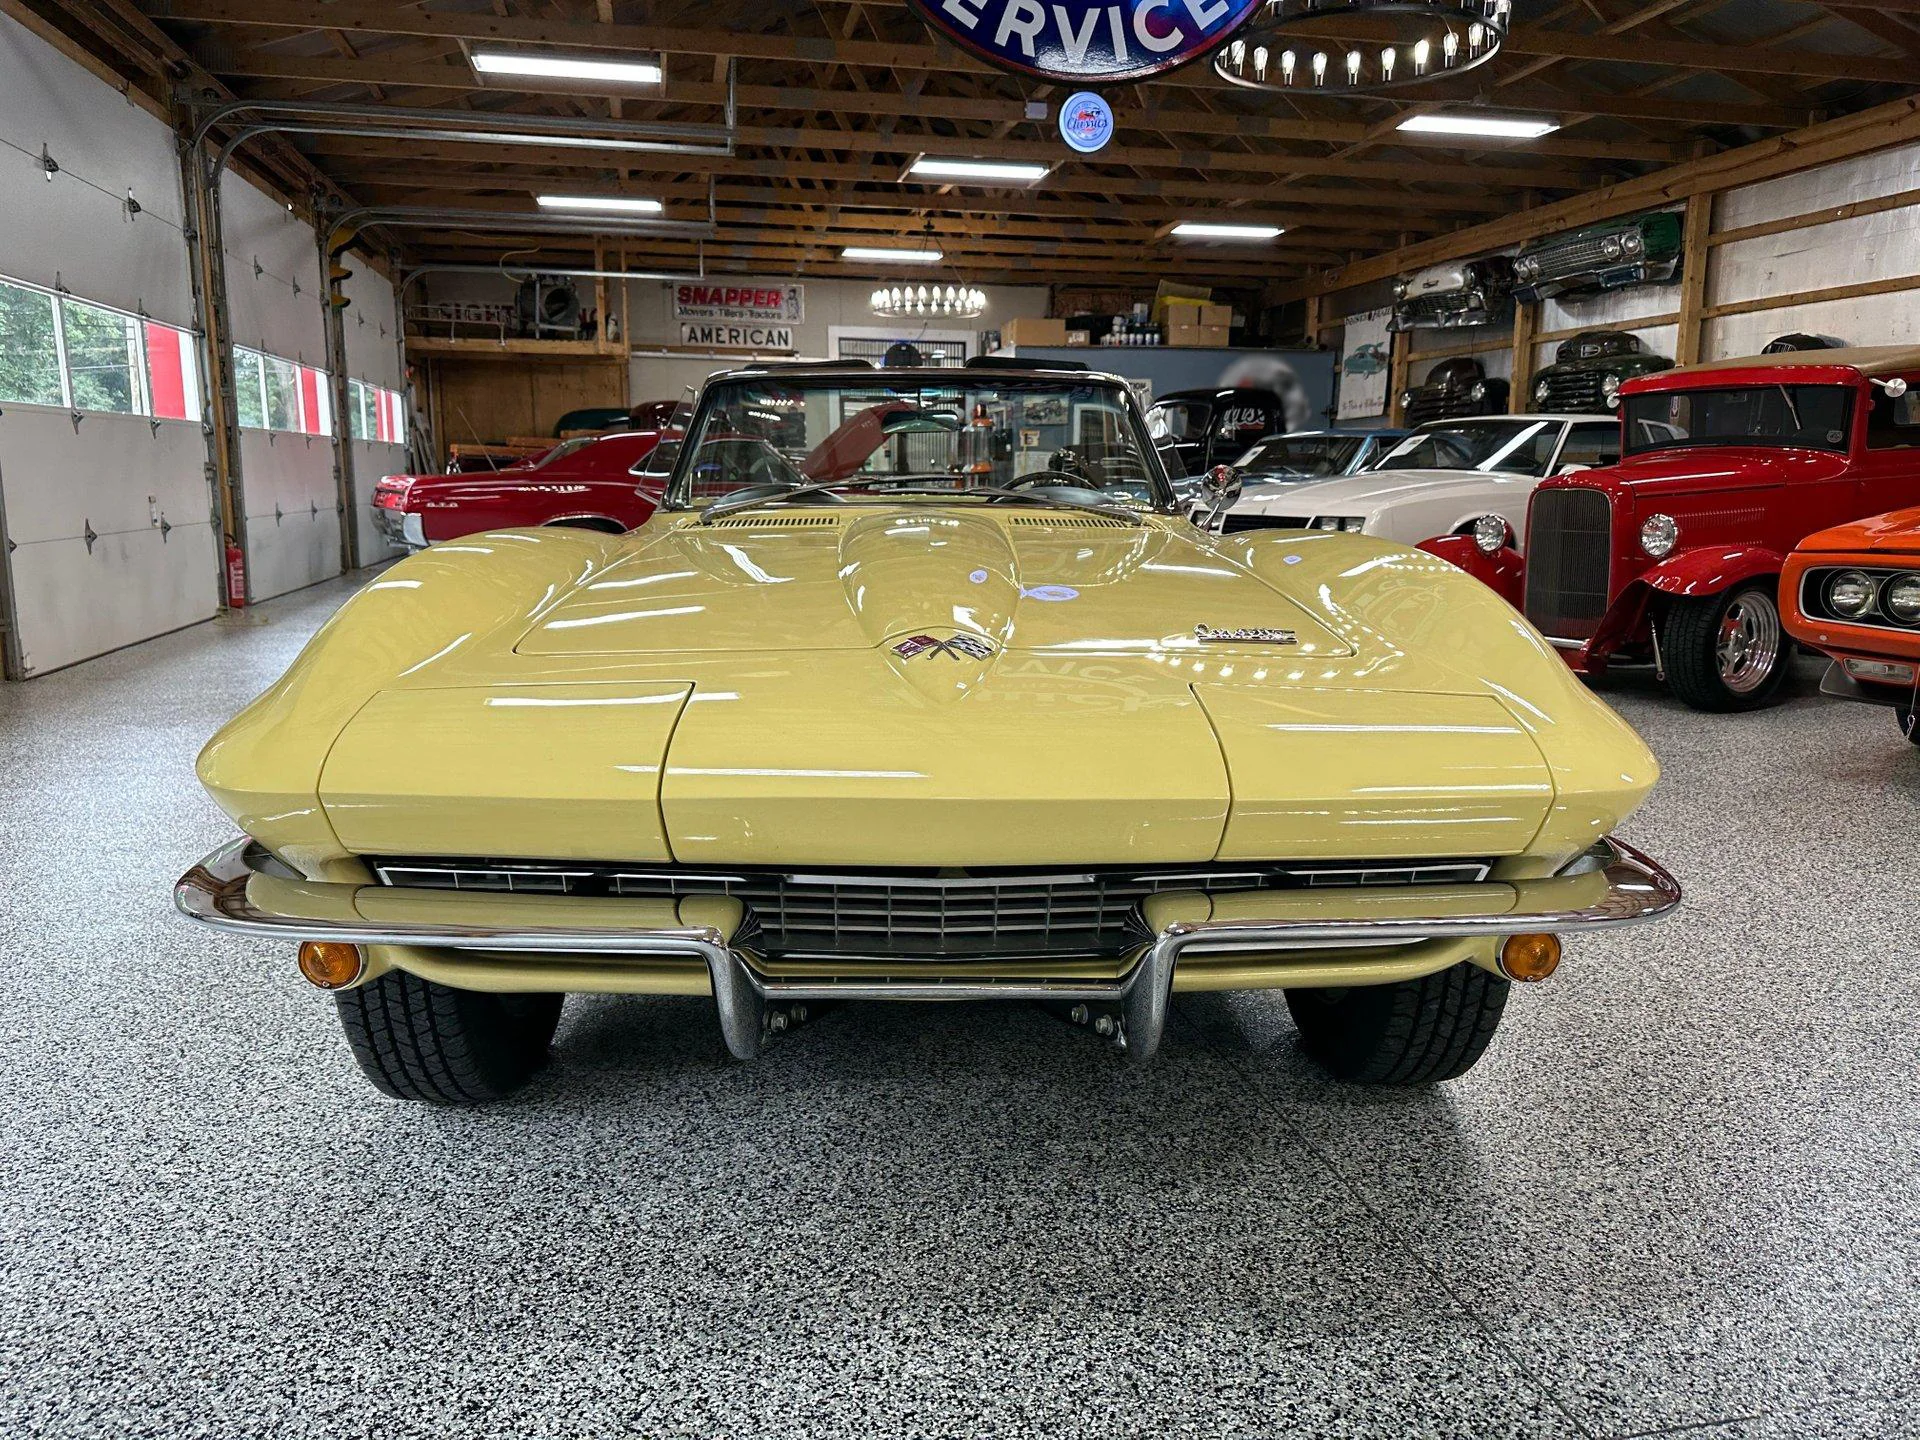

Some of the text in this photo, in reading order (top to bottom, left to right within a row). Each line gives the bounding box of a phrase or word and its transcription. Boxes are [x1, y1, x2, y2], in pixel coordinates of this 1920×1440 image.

[678, 286, 783, 308] SNAPPER
[679, 306, 782, 319] Mowers Tillers Tractors
[687, 327, 789, 347] AMERICAN
